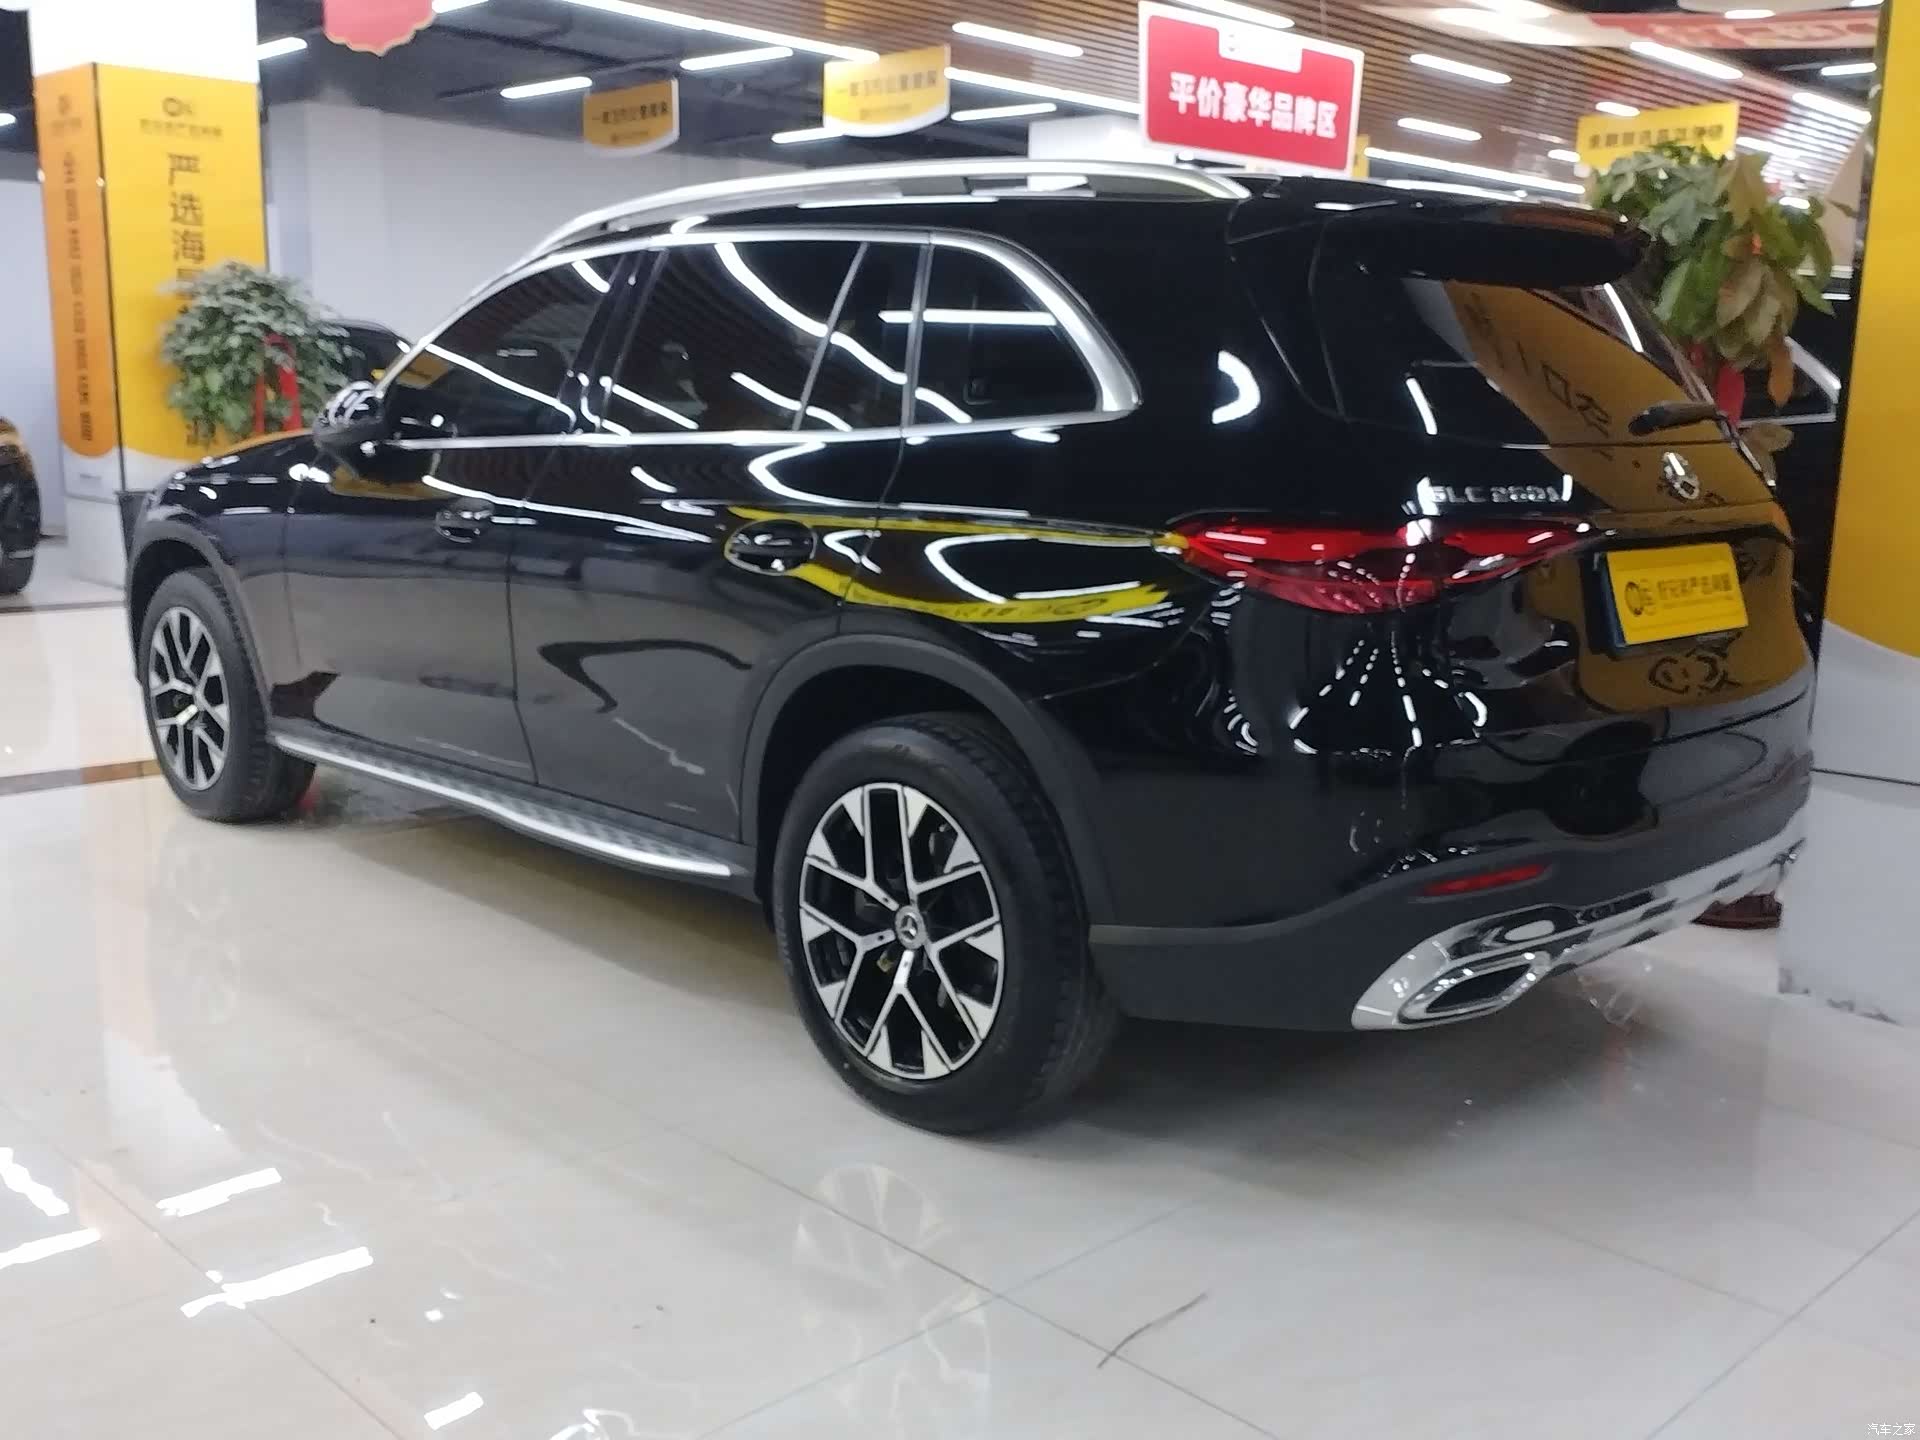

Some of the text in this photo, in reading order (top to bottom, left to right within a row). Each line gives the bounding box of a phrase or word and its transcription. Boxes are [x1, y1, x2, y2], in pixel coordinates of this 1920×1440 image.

[1168, 71, 1339, 139] 平价豪华品牌区
